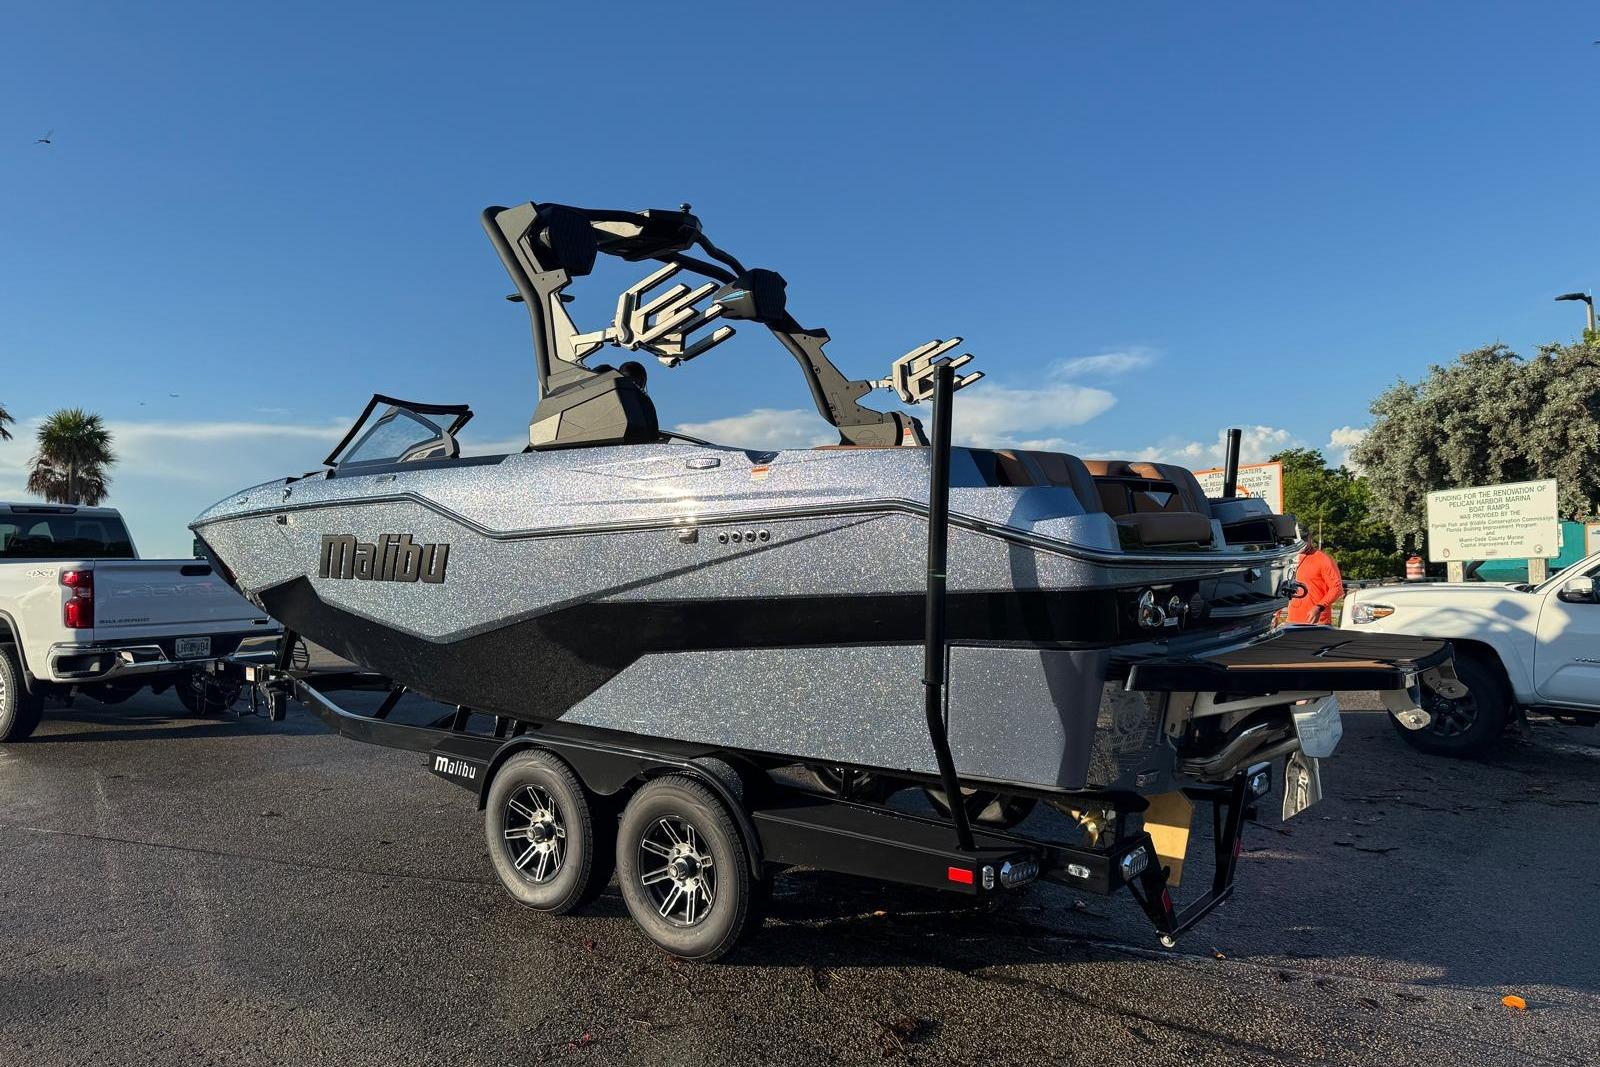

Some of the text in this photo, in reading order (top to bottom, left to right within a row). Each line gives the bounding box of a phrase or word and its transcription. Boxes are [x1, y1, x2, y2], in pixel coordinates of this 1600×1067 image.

[1246, 490, 1267, 498] ZONE
[1435, 493, 1462, 502] FUNDING
[1464, 492, 1476, 500] FOR
[1479, 490, 1491, 498] THE
[1493, 486, 1534, 497] RENOVATION
[1449, 495, 1531, 508] PELICAN HARBOR MARINA
[1488, 517, 1521, 525] Conservation
[1483, 524, 1515, 532] Improvement
[319, 533, 450, 584] Malibu
[434, 756, 476, 779] Malibu
